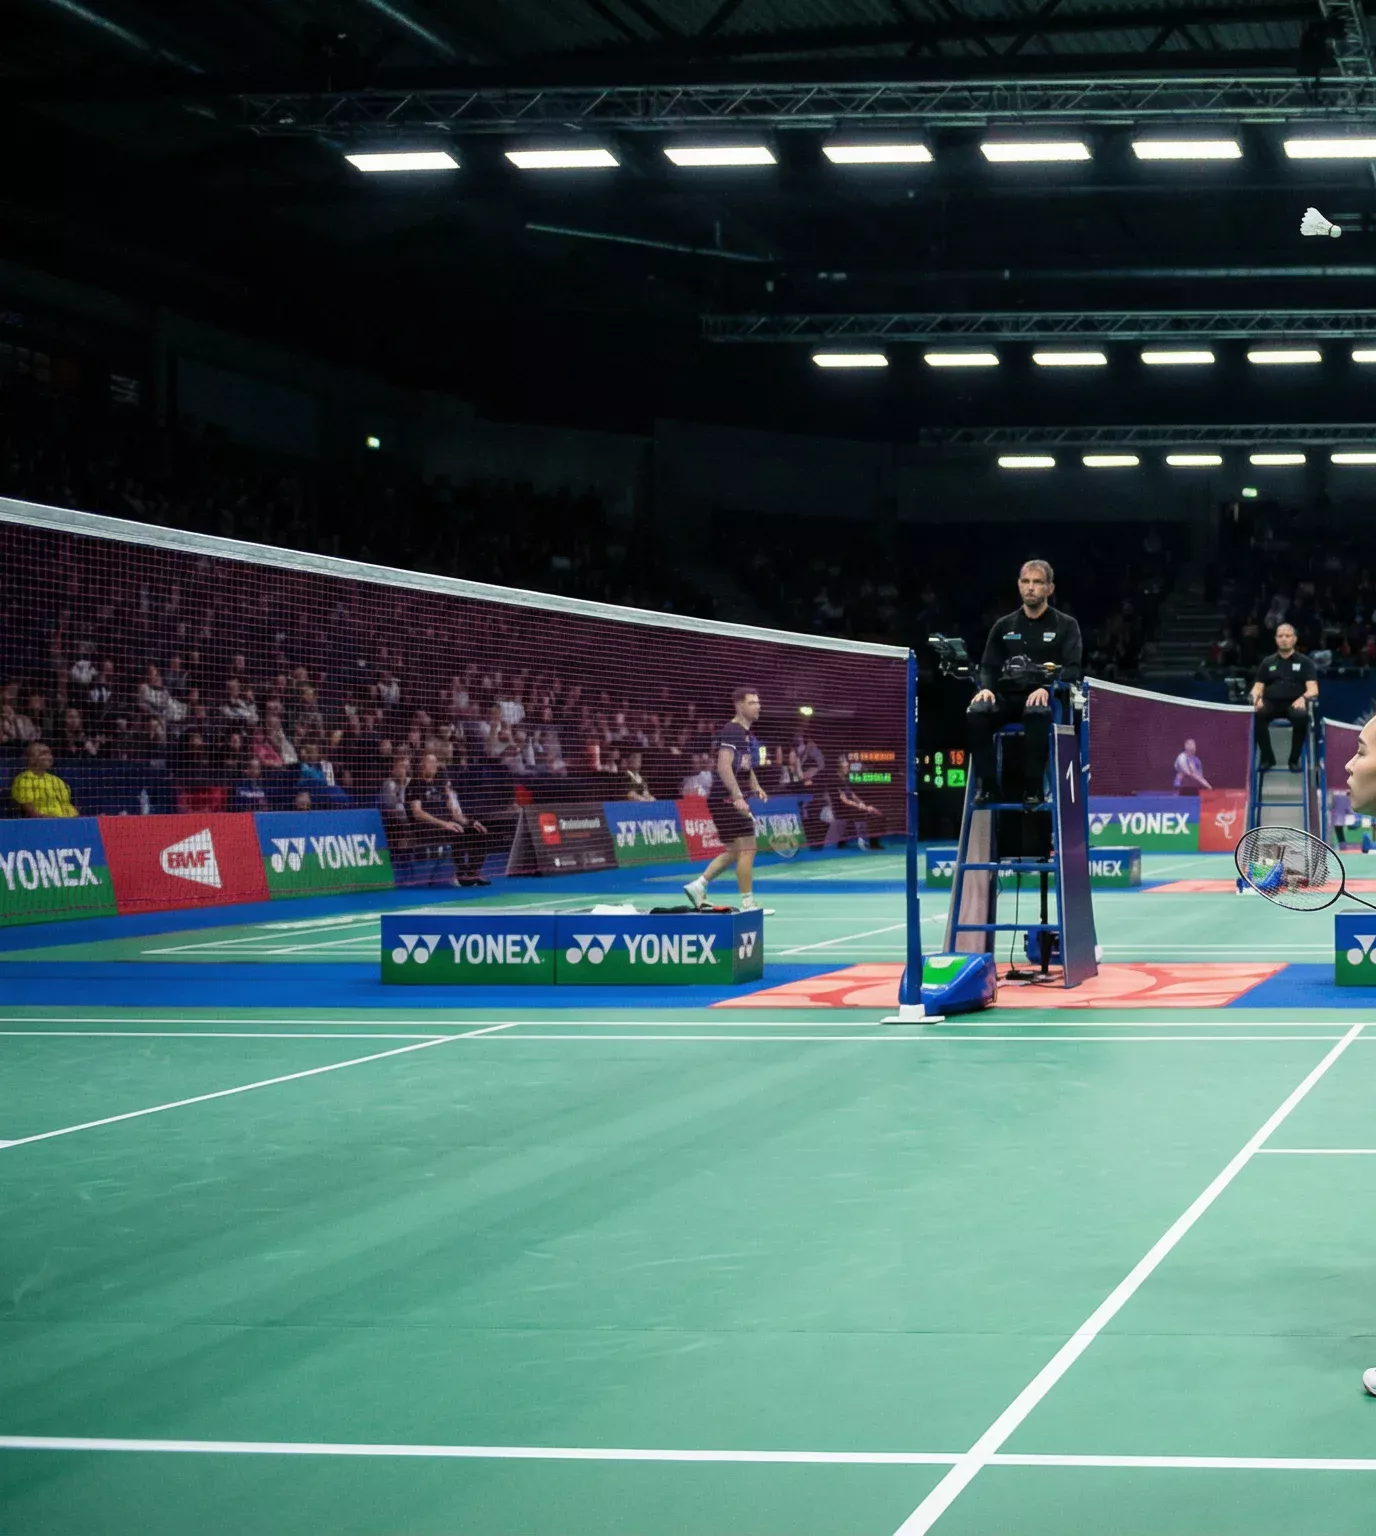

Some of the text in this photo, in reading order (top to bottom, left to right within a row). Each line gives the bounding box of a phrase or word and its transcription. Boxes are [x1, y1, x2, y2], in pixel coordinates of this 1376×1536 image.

[1066, 761, 1075, 803] 1
[637, 819, 681, 845] YONEX
[1118, 812, 1190, 834] YONEX
[167, 850, 210, 868] BWF
[310, 833, 383, 869] YONEX
[0, 848, 98, 890] YONEX
[1089, 860, 1122, 877] NEX
[448, 933, 541, 964] YONEX
[623, 933, 717, 964] YONEX
